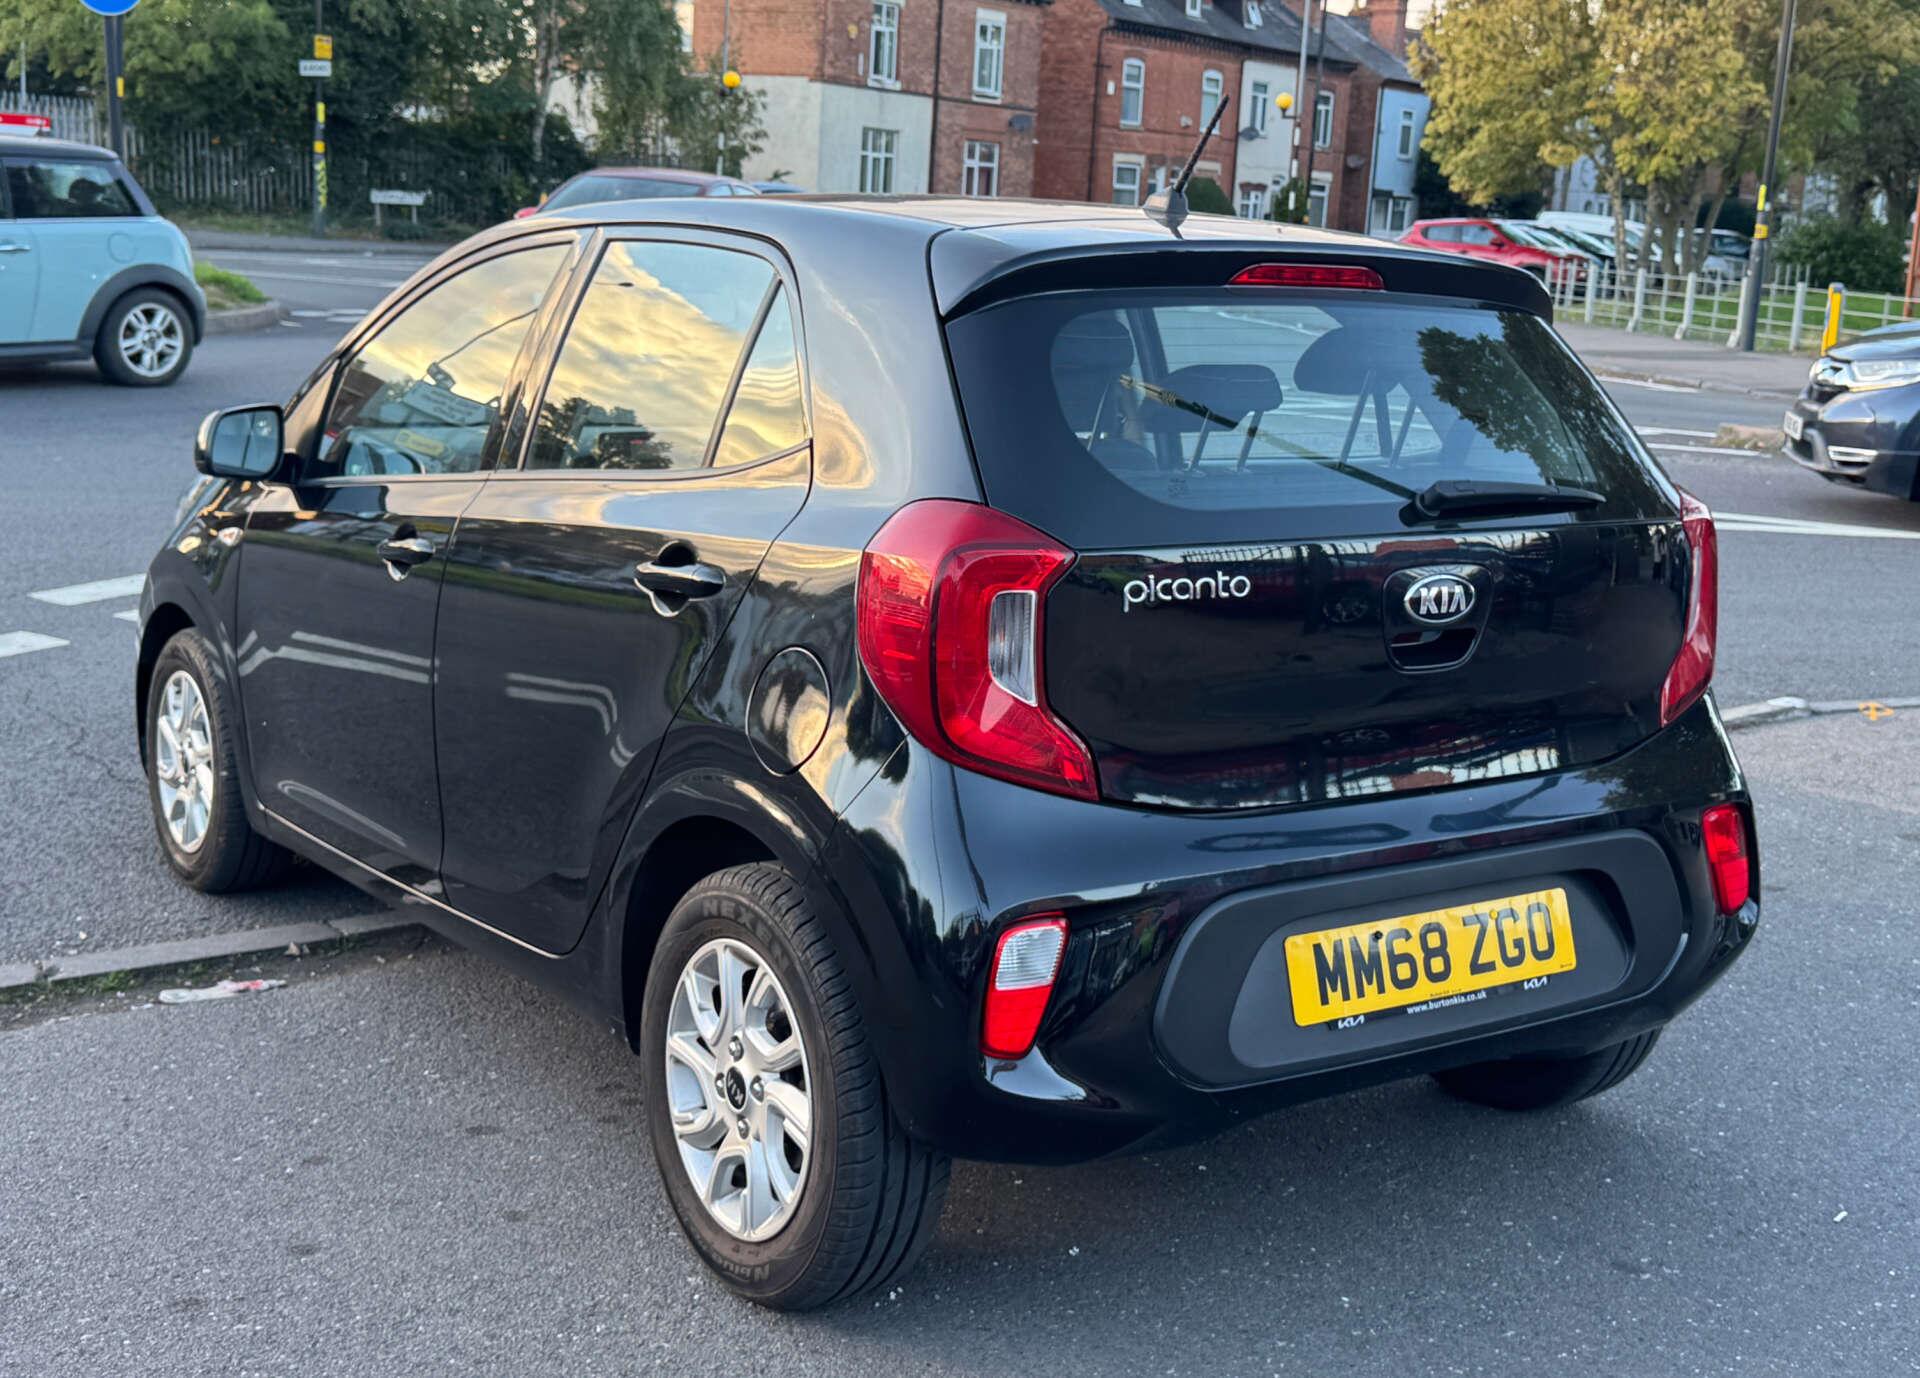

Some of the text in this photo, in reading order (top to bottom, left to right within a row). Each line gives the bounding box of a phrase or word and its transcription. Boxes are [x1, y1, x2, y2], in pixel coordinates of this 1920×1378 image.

[1123, 570, 1250, 612] picanto
[1419, 584, 1466, 615] KIA
[1313, 902, 1556, 1006] MM68 ZGO
[1406, 990, 1487, 1014] www.burtonkia.co.uk
